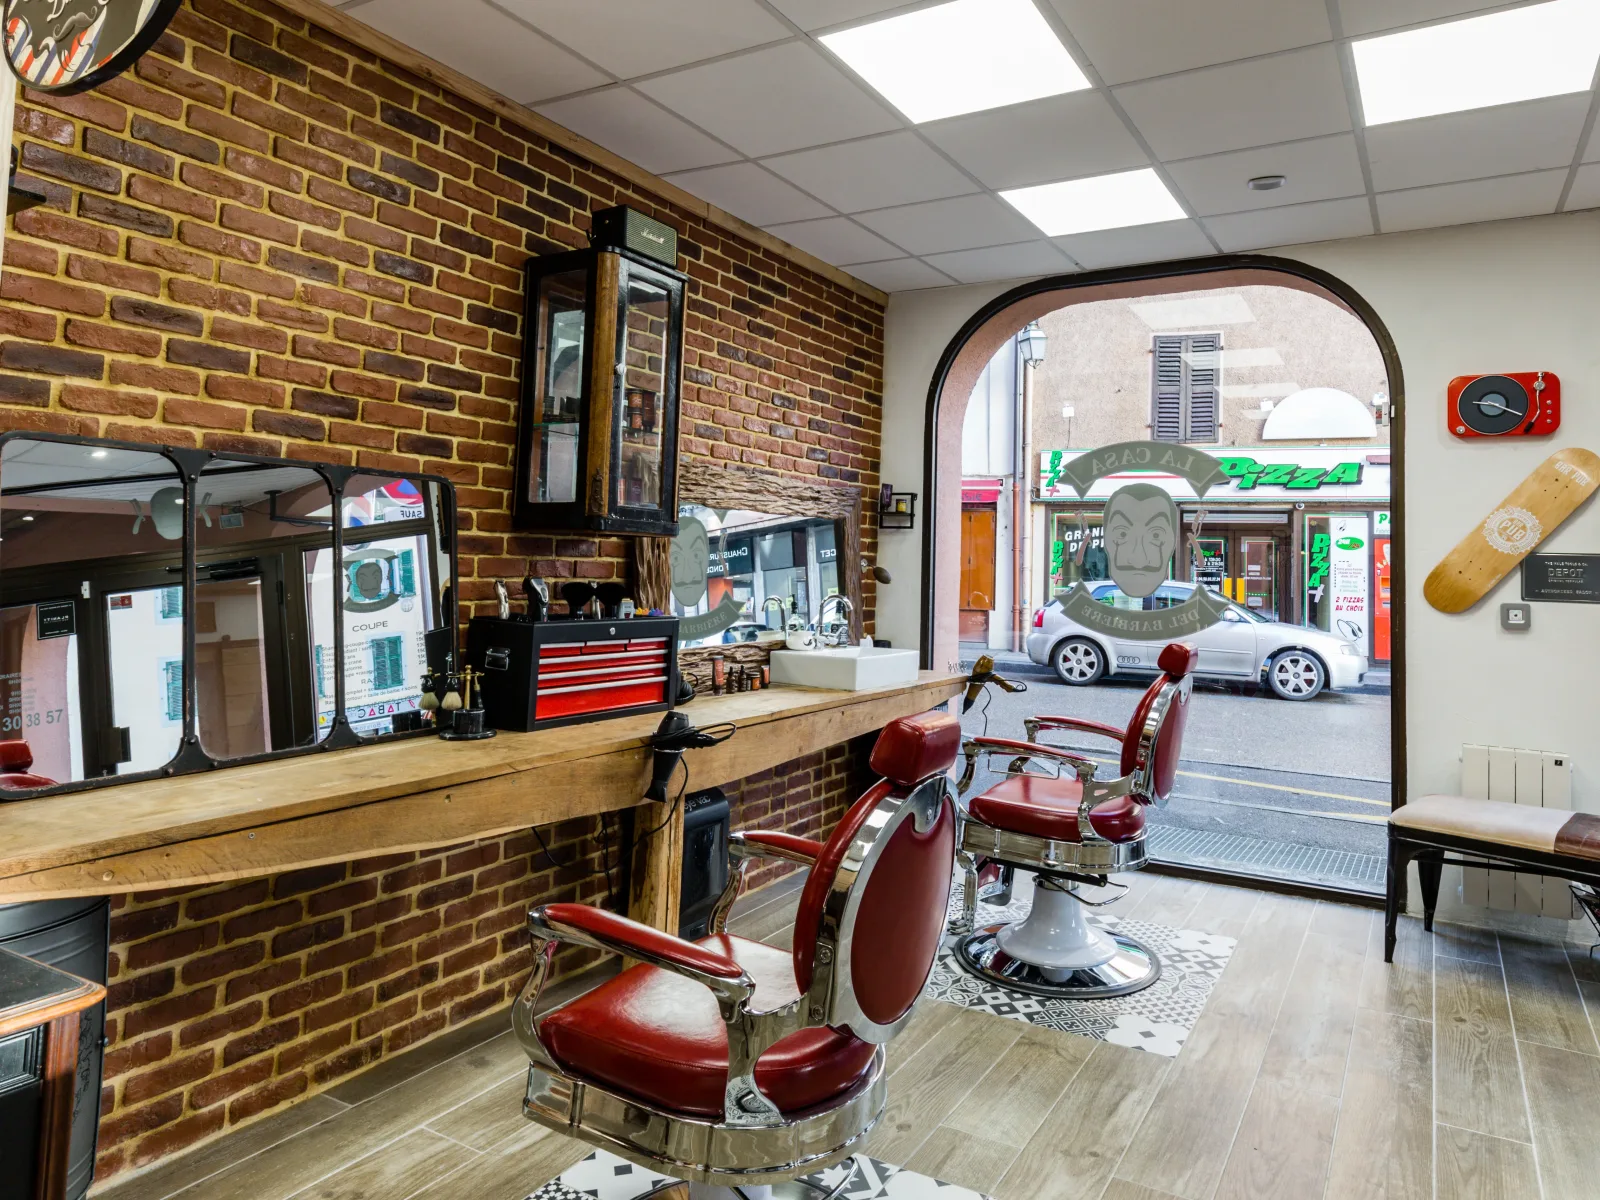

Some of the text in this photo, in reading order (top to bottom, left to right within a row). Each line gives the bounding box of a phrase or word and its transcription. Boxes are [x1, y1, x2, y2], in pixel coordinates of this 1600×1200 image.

[1499, 520, 1527, 541] PUB
[1547, 567, 1584, 577] DEPOT
[351, 620, 388, 632] COUPE
[2, 709, 64, 732] 30 38 57
